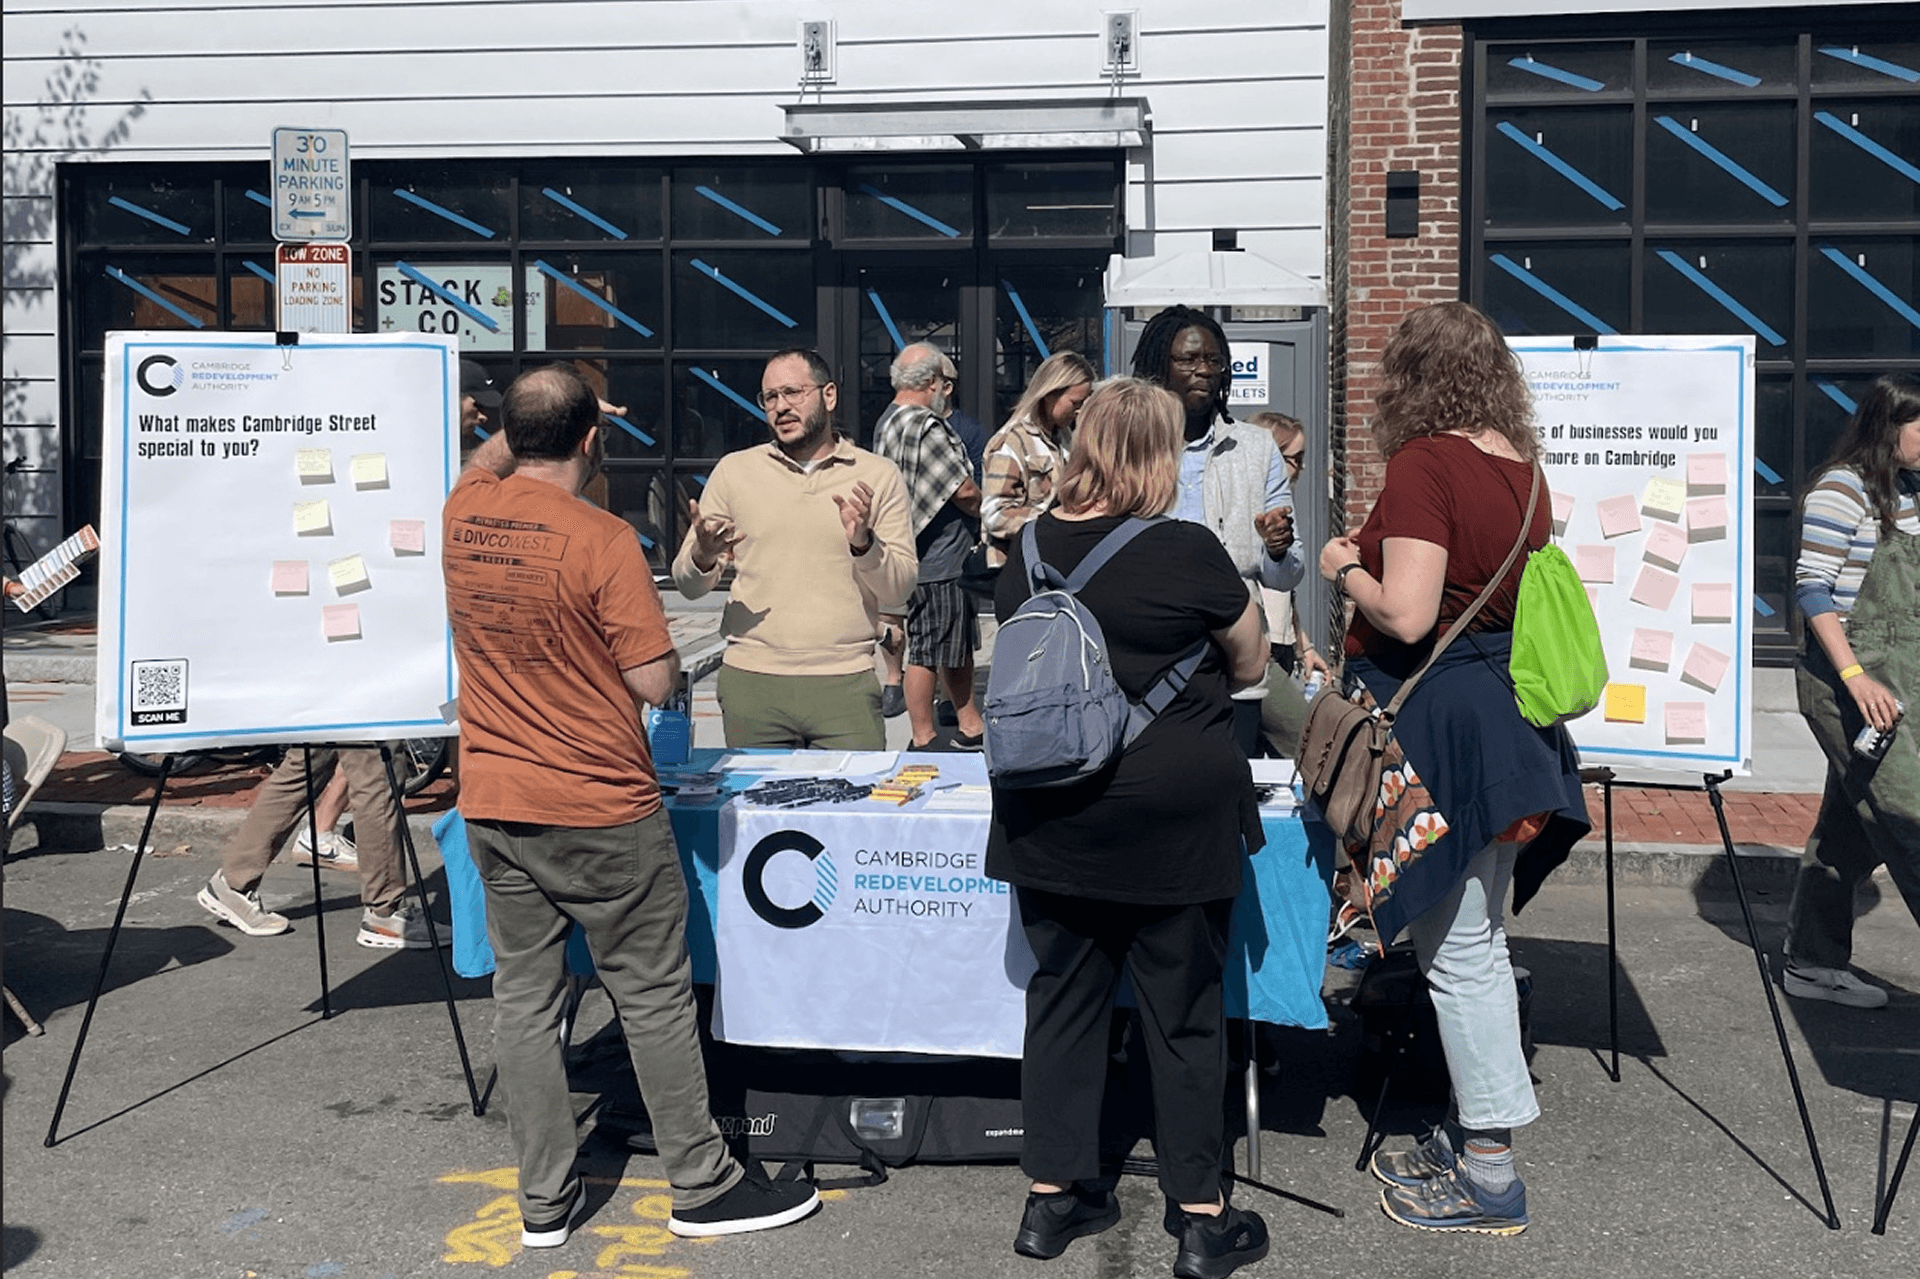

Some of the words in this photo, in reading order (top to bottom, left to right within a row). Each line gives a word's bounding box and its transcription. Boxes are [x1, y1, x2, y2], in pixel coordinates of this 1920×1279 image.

[296, 136, 327, 153] 30
[283, 158, 339, 173] MINUTE
[278, 175, 344, 190] PARKING
[279, 223, 291, 231] EX
[325, 223, 345, 232] SUN
[284, 247, 307, 261] TOW
[311, 247, 344, 261] ZONE
[306, 267, 320, 278] NO
[291, 281, 336, 293] PARKING
[380, 279, 482, 306] STACK
[284, 295, 319, 306] LOADING
[322, 295, 344, 306] ZONE
[191, 361, 252, 371] CAMBRIDGE
[191, 372, 279, 381] REDEVELOPMENT
[191, 382, 250, 391] AUTHORITY
[1231, 388, 1266, 398] ILETS
[139, 414, 180, 432] What
[186, 415, 236, 432] makes
[242, 415, 322, 435] Cambridge
[329, 414, 377, 431] Street
[1551, 424, 1564, 439] of
[1570, 424, 1642, 439] businesses
[1648, 424, 1688, 440] would
[1693, 427, 1718, 443] you
[137, 439, 194, 459] special
[201, 441, 216, 457] to
[222, 438, 260, 459] you?
[1545, 452, 1579, 466] more
[1584, 452, 1600, 466] on
[1605, 450, 1676, 468] Cambridge
[137, 713, 164, 723] SCAN
[166, 712, 180, 721] ME
[854, 850, 978, 869] CAMBRIDGE
[854, 874, 1012, 894] REDEVELOPME
[854, 898, 973, 918] AUTHORITY
